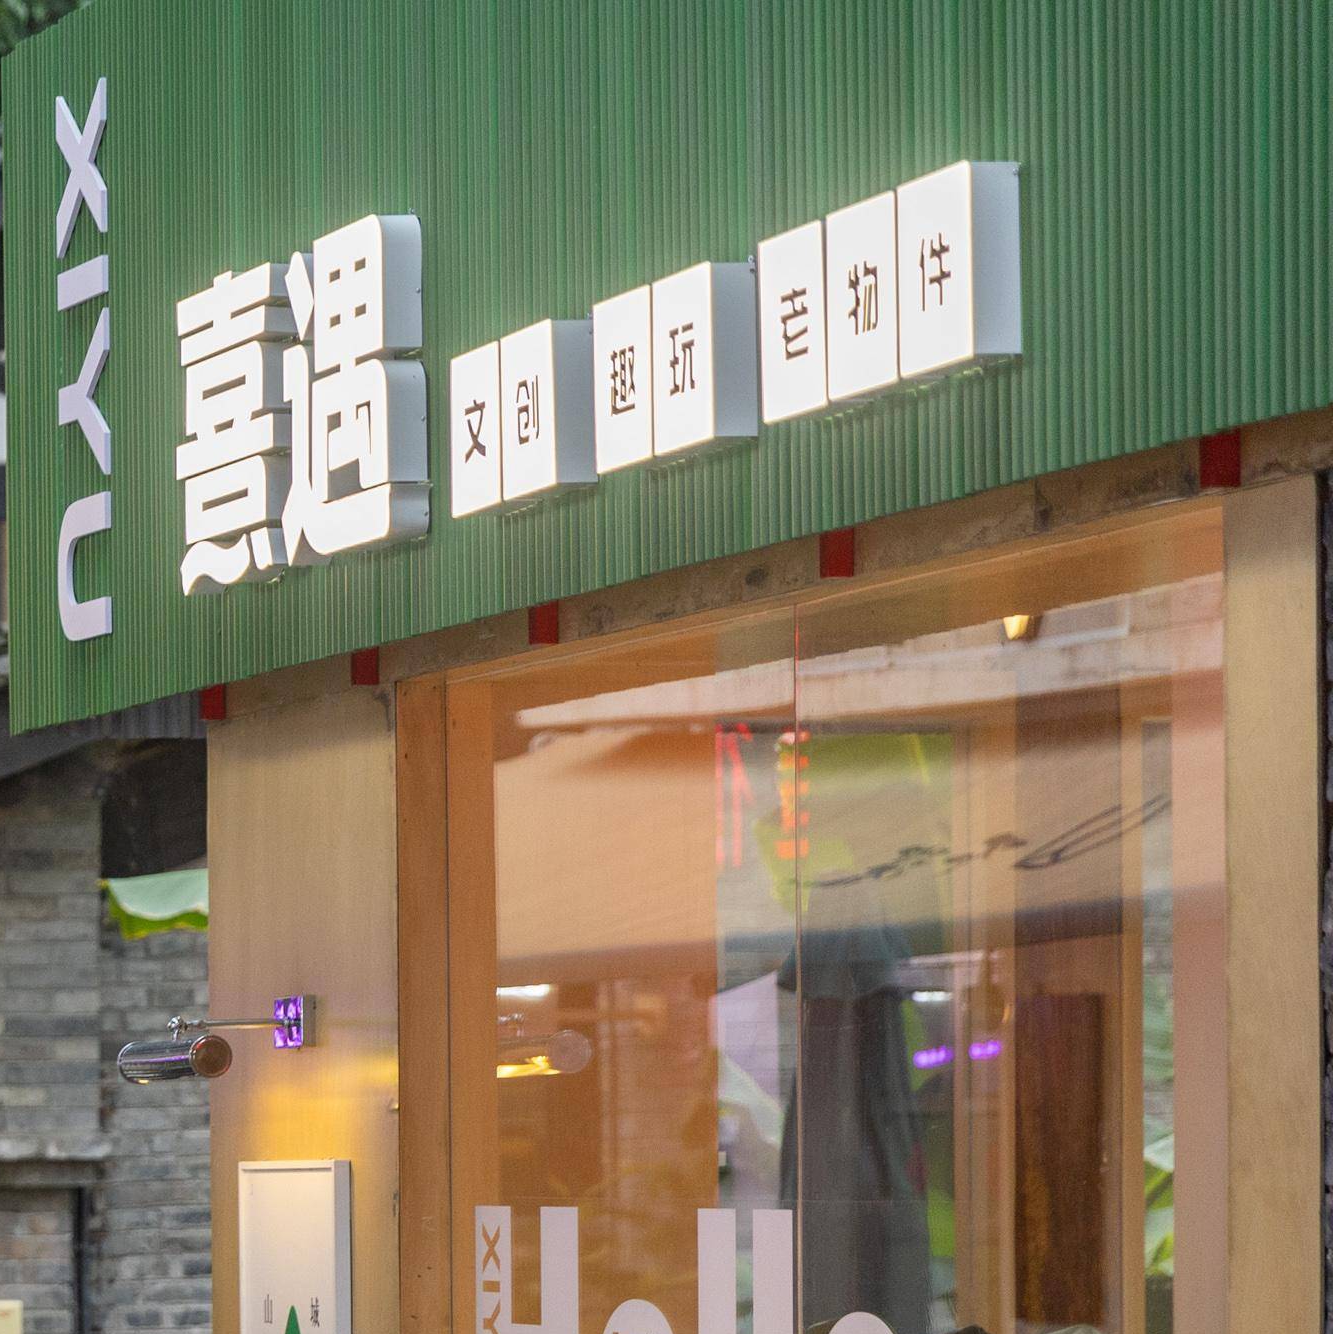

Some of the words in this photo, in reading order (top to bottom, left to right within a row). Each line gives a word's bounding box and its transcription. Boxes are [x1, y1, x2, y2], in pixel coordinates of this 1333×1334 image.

[54, 76, 113, 642] XIYU
[175, 213, 401, 597] 喜遇
[463, 374, 541, 464] 文创
[608, 320, 698, 419] 趣玩
[779, 231, 953, 362] 老物件
